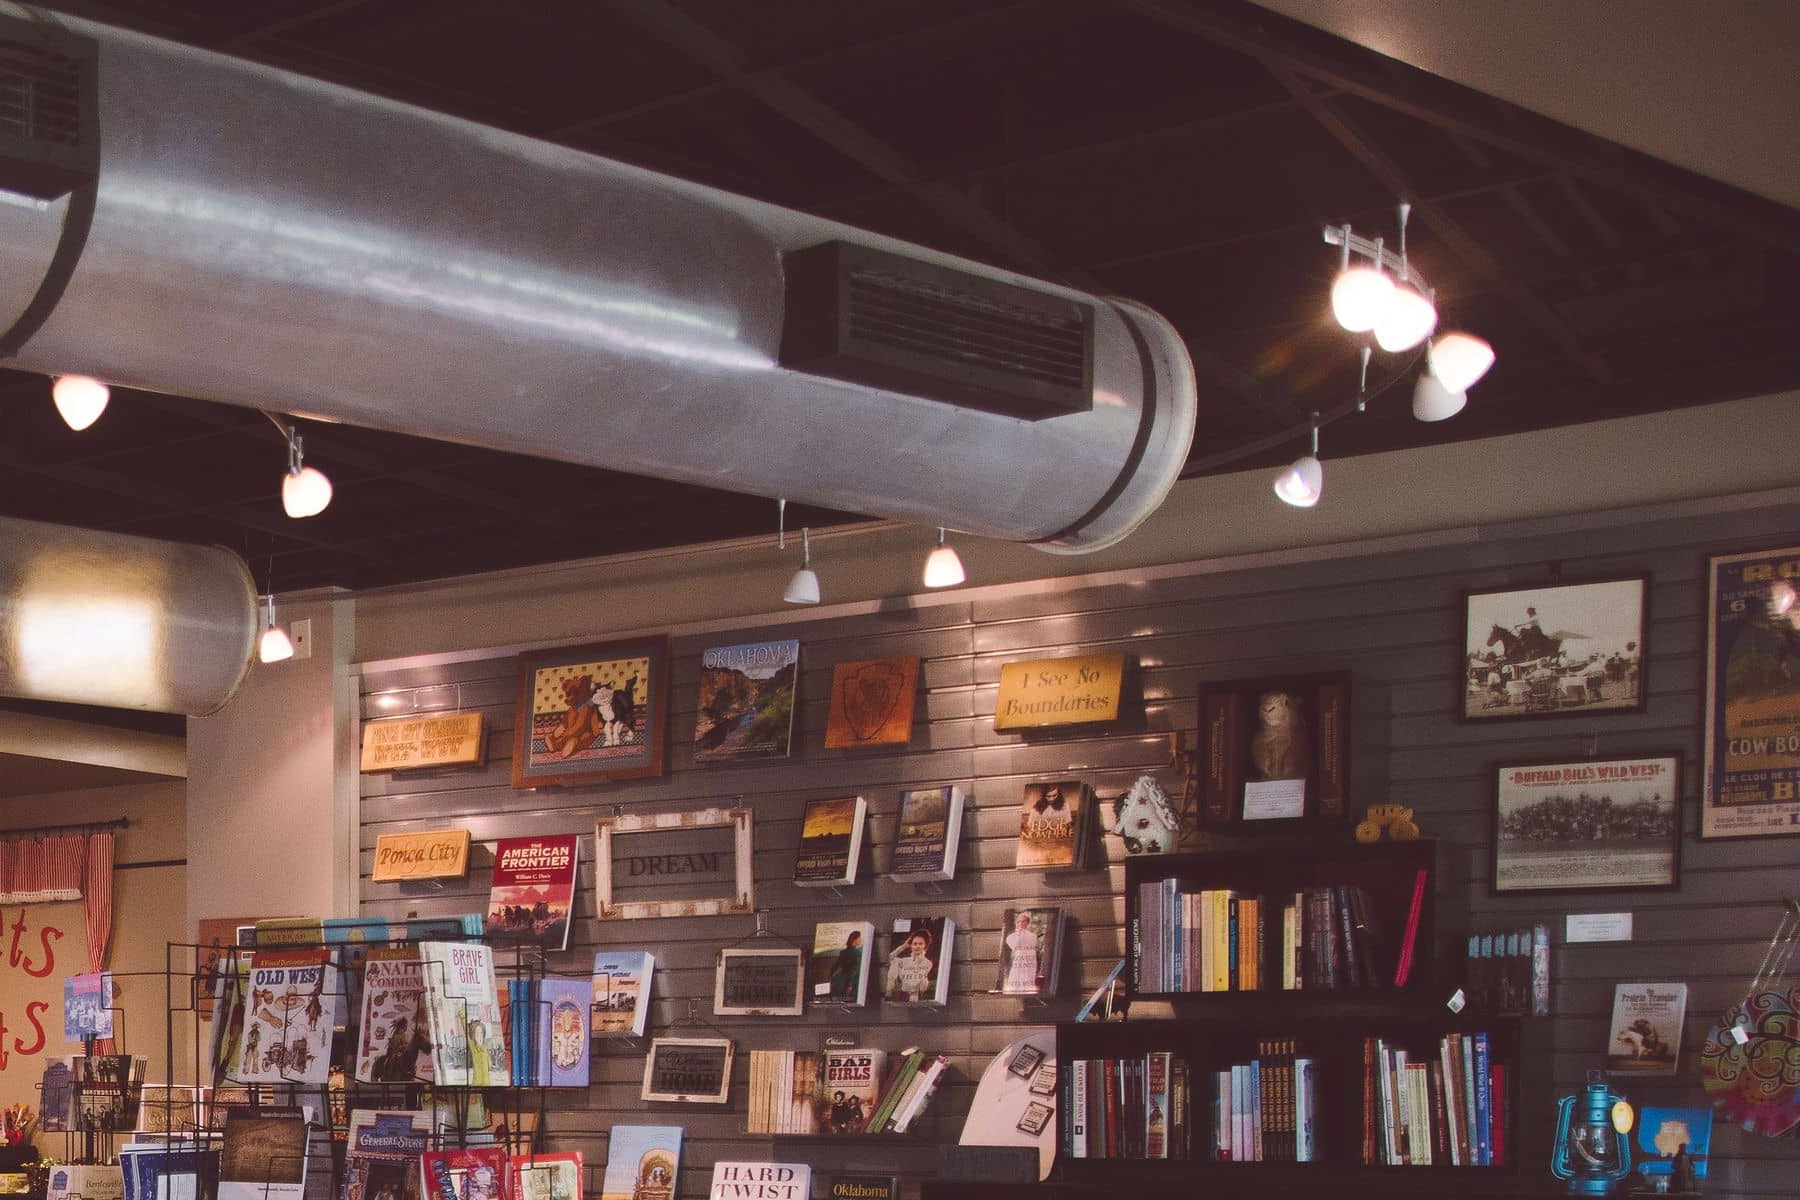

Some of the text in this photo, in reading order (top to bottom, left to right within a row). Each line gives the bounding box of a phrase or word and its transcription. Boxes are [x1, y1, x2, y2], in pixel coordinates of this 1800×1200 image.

[703, 645, 792, 669] OKLAHOMA
[1037, 671, 1069, 688] See
[1077, 667, 1100, 688] No
[1006, 694, 1110, 716] Boundaries
[380, 842, 462, 865] Ponca City
[503, 846, 569, 859] AMERICAN
[501, 856, 569, 869] FRONTIER
[630, 854, 719, 876] DREAM
[452, 948, 483, 968] BRAVE
[256, 969, 284, 985] OLD
[459, 967, 481, 985] GIRL
[828, 1057, 872, 1068] BAD
[828, 1067, 871, 1081] GIRLS
[360, 1133, 425, 1150] GENERAL STORE
[723, 1167, 794, 1182] HARD
[716, 1183, 799, 1200] TWIST
[833, 1183, 888, 1198] Oklahoma
